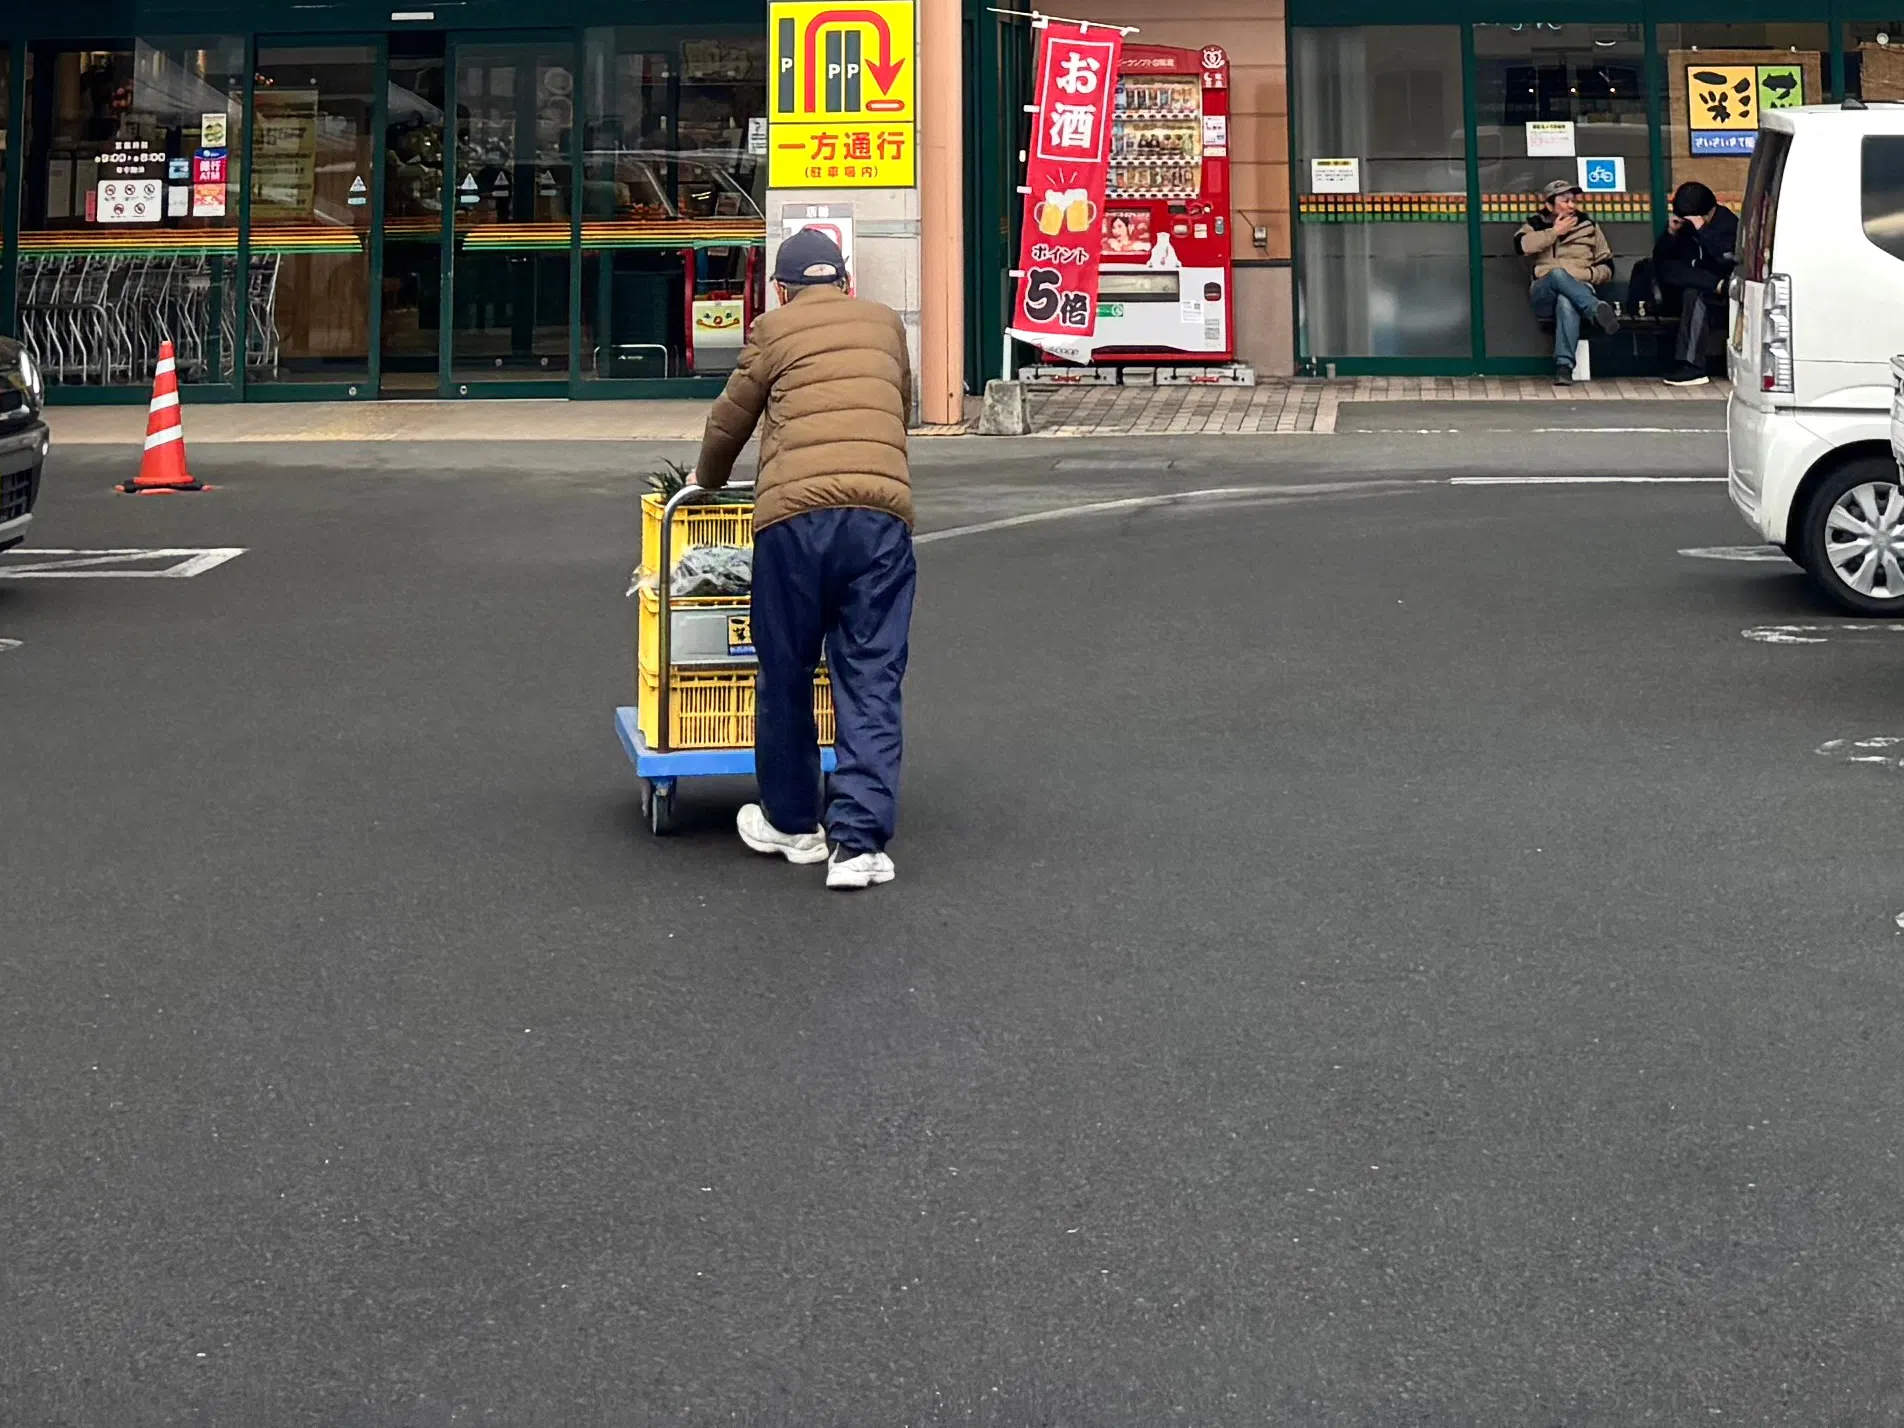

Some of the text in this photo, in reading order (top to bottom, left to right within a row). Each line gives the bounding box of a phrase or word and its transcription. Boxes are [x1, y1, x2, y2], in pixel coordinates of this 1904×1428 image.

[781, 58, 793, 72] P
[829, 64, 840, 79] P
[847, 64, 859, 79] P
[1049, 51, 1101, 149] お酒
[778, 131, 905, 160] 一方通行
[1031, 244, 1089, 265] ポイント
[1024, 266, 1090, 328] 5倍
